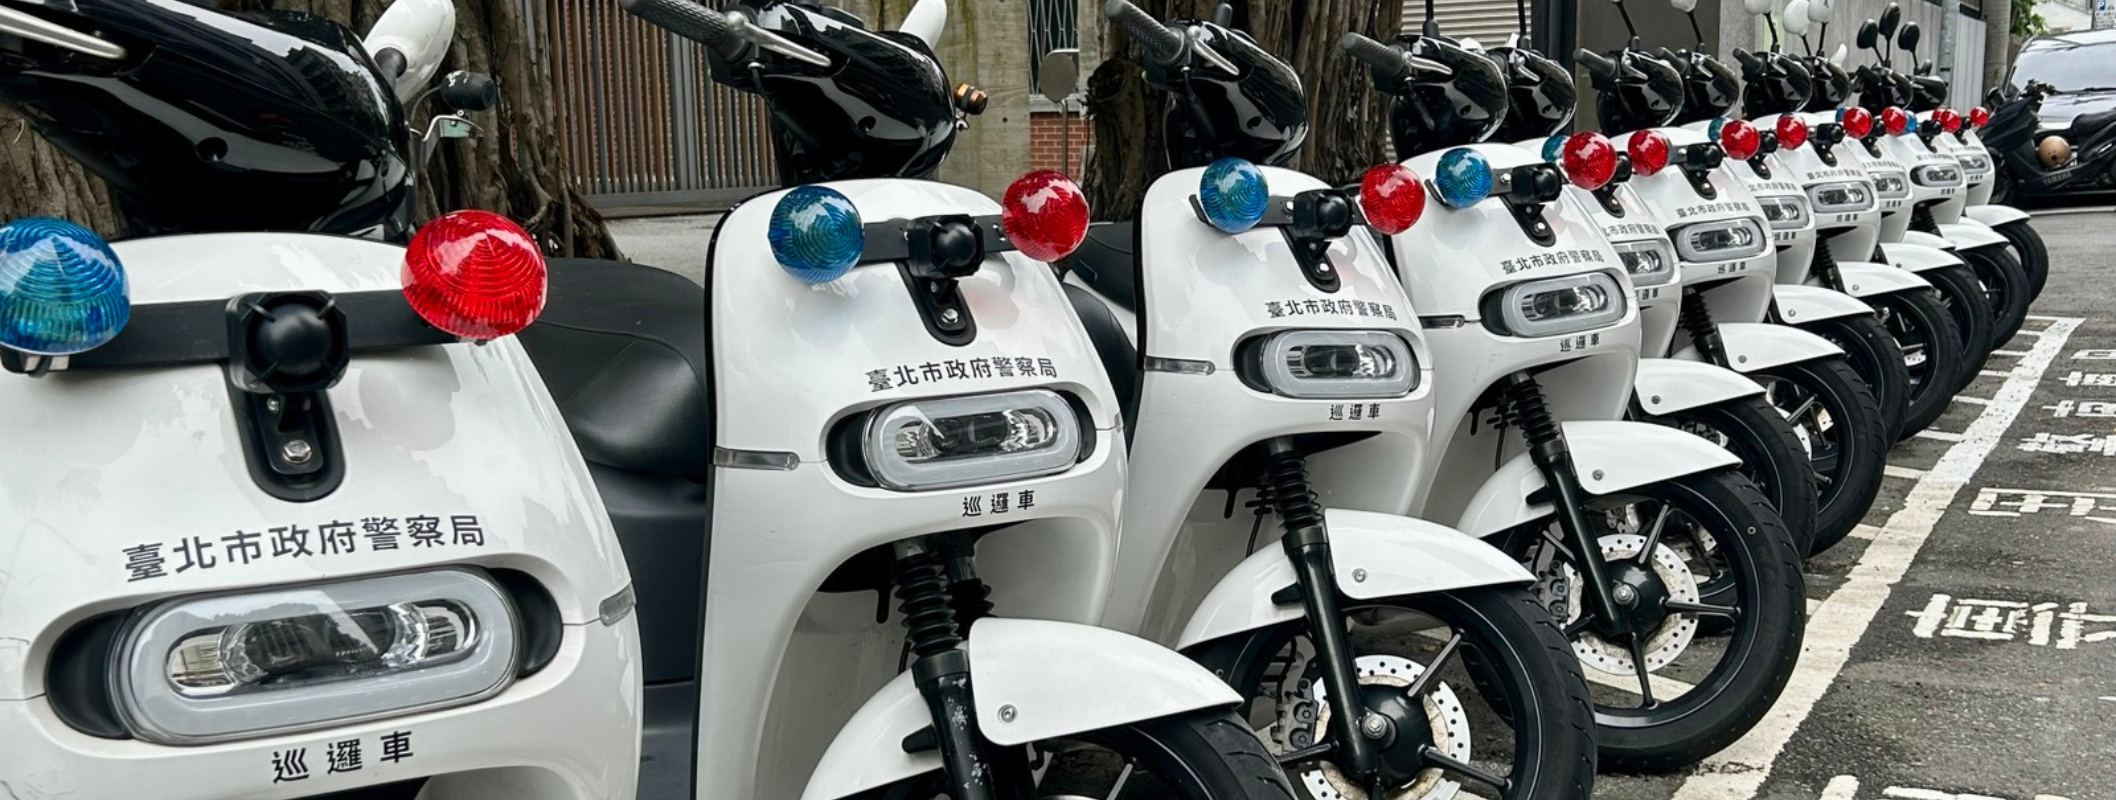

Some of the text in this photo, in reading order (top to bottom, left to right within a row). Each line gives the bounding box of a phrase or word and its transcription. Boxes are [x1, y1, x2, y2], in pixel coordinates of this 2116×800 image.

[1500, 249, 1604, 275] 臺北市政府警察局
[1265, 298, 1397, 321] 臺北市政府警察局
[865, 356, 1058, 393] 臺北市政府警察局
[1328, 402, 1381, 421] 巡邏車
[962, 489, 1035, 518] 巡邏車
[122, 514, 485, 583] 臺北市政府警察局
[271, 730, 414, 784] 巡邏車
